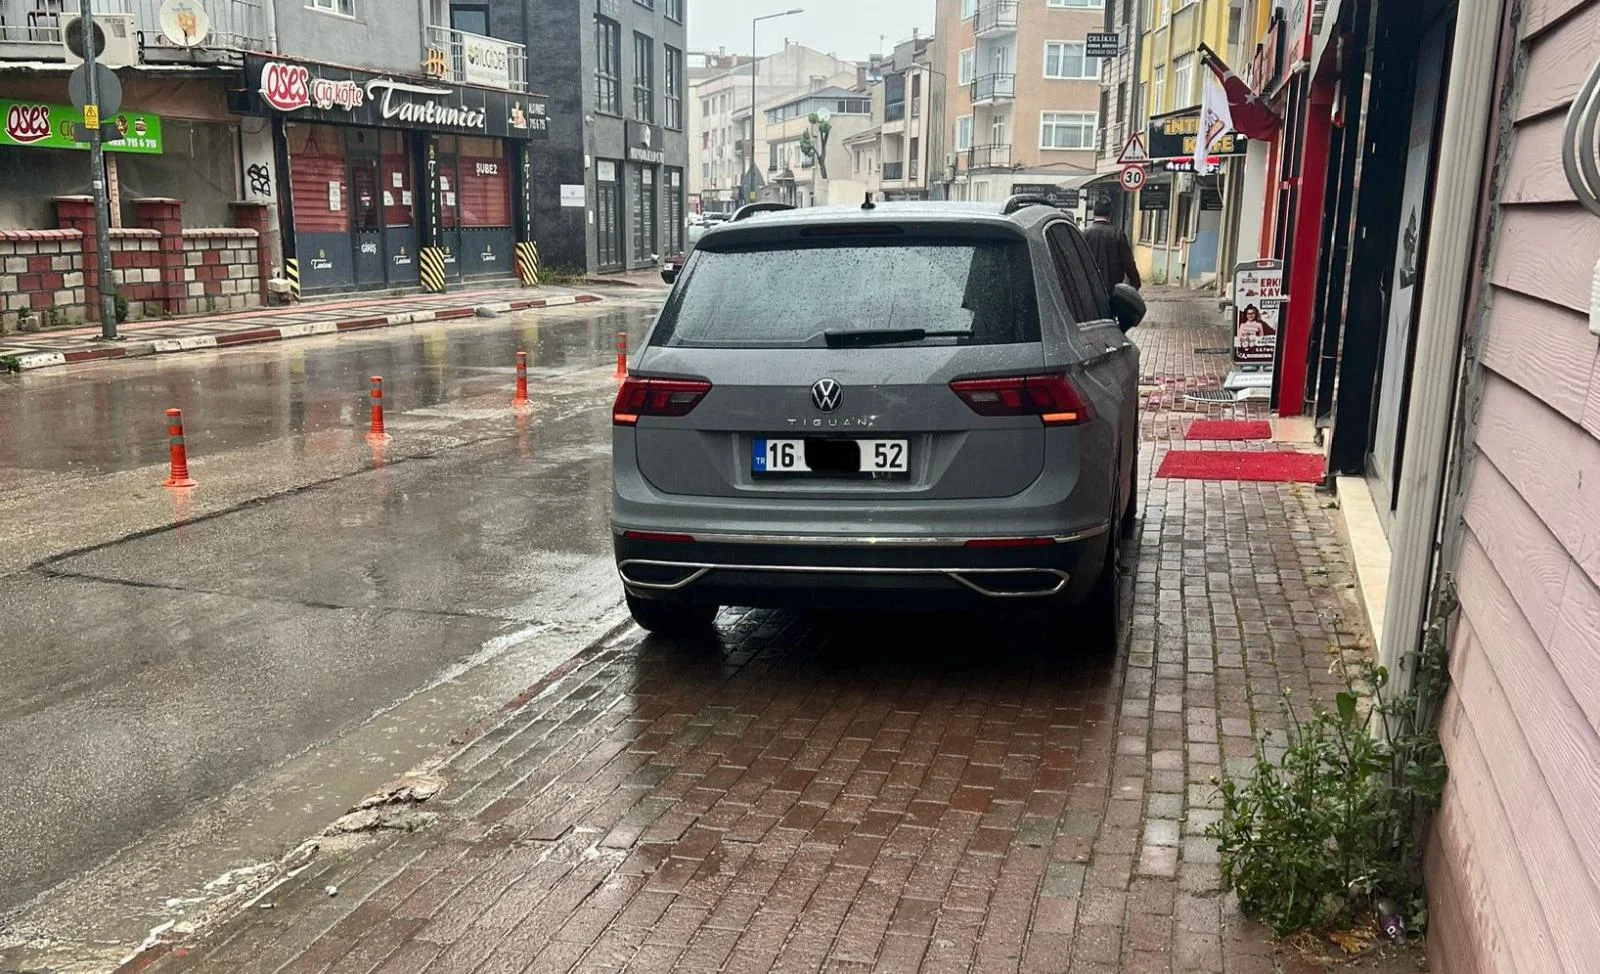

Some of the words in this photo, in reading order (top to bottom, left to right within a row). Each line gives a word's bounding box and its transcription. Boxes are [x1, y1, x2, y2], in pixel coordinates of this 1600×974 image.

[335, 82, 364, 108] köfte
[1125, 171, 1141, 183] 30
[1260, 278, 1280, 287] ERK
[1260, 288, 1280, 297] KAY
[787, 419, 867, 427] TIGUAN
[769, 443, 795, 468] 16
[874, 443, 903, 468] 52
[755, 457, 766, 465] TR
